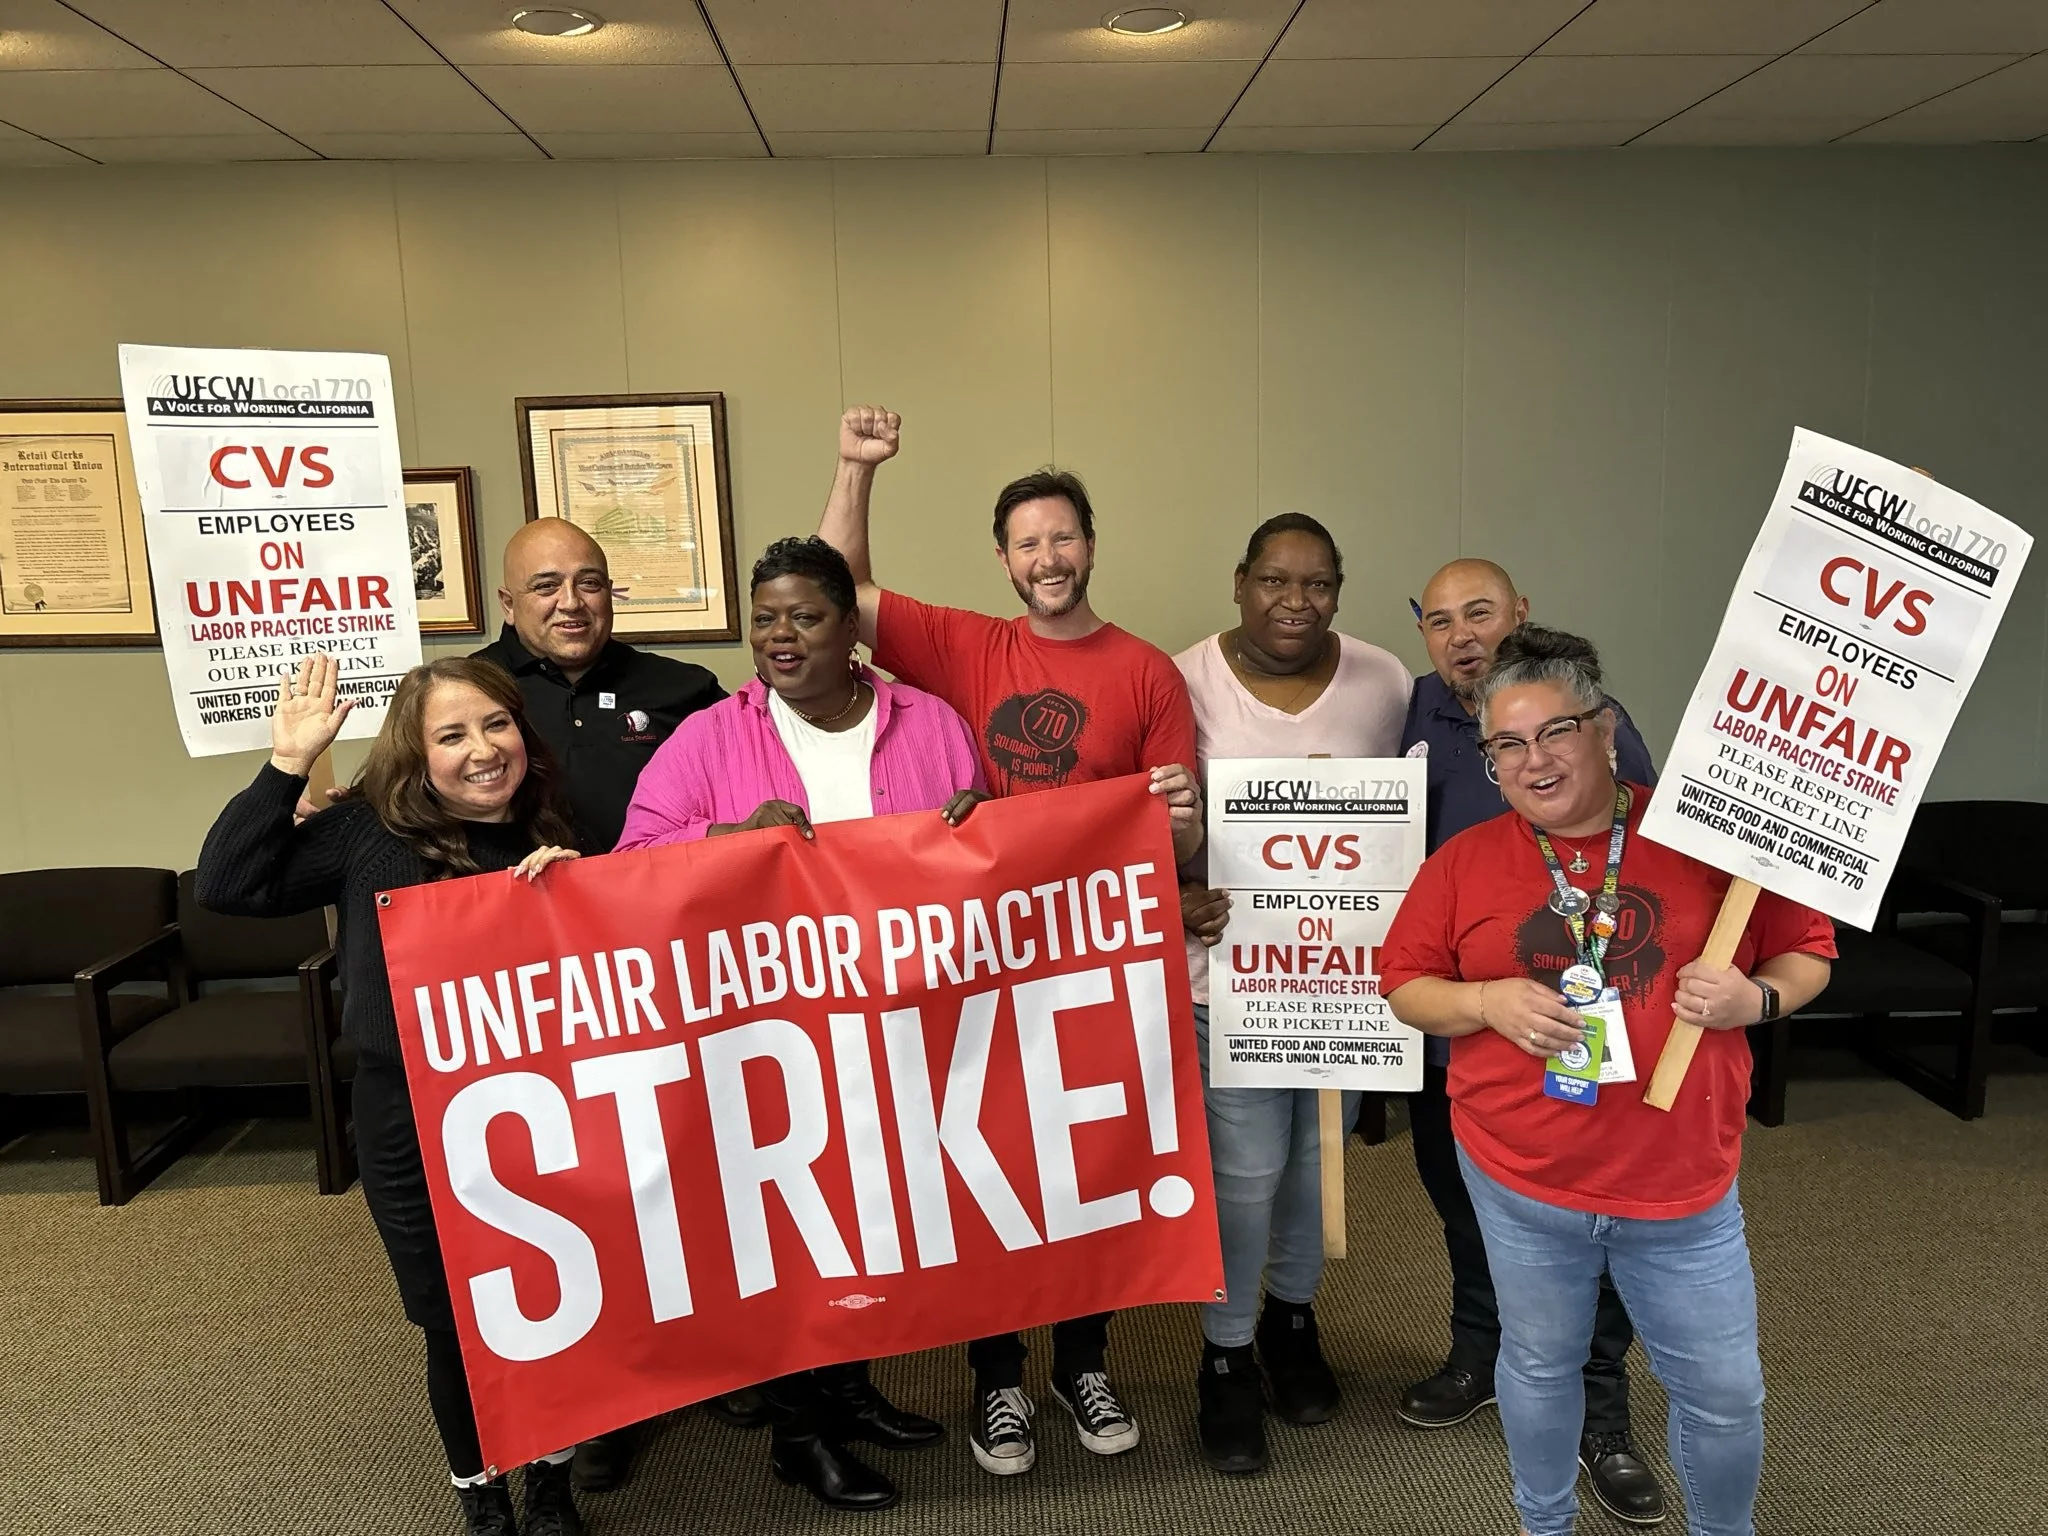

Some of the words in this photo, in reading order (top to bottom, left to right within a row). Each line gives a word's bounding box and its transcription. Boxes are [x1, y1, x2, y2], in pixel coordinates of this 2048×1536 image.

[171, 375, 254, 400] UFCW
[257, 377, 321, 400] Local
[325, 378, 371, 400] 770
[152, 401, 164, 412] A
[166, 401, 204, 413] VOICE
[208, 403, 231, 413] FOR
[234, 402, 296, 415] WORKING
[298, 402, 369, 415] CALIFORNIA
[3, 461, 68, 472] International
[73, 460, 103, 470] Union
[18, 450, 47, 460] Retail
[51, 450, 84, 460] Clerks
[209, 445, 334, 489] CVS
[198, 513, 355, 535] EMPLOYEES
[1832, 468, 1908, 522] UFCW
[1904, 502, 1963, 549] Local
[1961, 530, 2008, 568] 770
[1804, 486, 1815, 497] A
[1818, 491, 1850, 517] VOICE
[1852, 508, 1873, 527] FOR
[1875, 517, 1927, 552] WORKING
[1927, 543, 1992, 581] CALIFORNIA
[260, 541, 304, 571] ON
[186, 575, 392, 618] UNFAIR
[1820, 556, 1935, 637] CVS
[191, 622, 246, 642] LABOR
[251, 617, 333, 638] PRACTICE
[338, 614, 396, 633] STRIKE
[208, 643, 283, 662] PLEASE
[289, 637, 378, 655] RESPECT
[1778, 613, 1918, 690] EMPLOYEES
[208, 666, 251, 682] OUR
[255, 662, 302, 678] PICK
[337, 656, 385, 671] LINE
[197, 693, 241, 710] UNITED
[244, 689, 280, 704] FOOD
[336, 679, 398, 695] MMERCIAL
[1815, 665, 1859, 707] ON
[200, 707, 261, 725] WORKERS
[1031, 706, 1069, 739] 770
[1726, 668, 1913, 782] UNFAIR
[993, 733, 1042, 760] SOLIDARITY
[1712, 710, 1768, 750] LABOR
[1768, 734, 1845, 782] PRACTICE
[1843, 769, 1900, 807] STRIKE
[1011, 758, 1020, 771] IS
[1247, 780, 1311, 800] UFCW
[1315, 780, 1365, 800] Local
[1370, 780, 1408, 800] 770
[1718, 743, 1787, 784] PLEASE
[1790, 775, 1873, 821] RESPECT
[1229, 801, 1238, 811] A
[1240, 801, 1270, 811] VOICE
[1272, 802, 1291, 811] FOR
[1293, 801, 1342, 812] WORKING
[1344, 801, 1404, 812] CALIFORNIA
[1707, 763, 1747, 791] OUR
[1751, 781, 1820, 823] PICKET
[1819, 812, 1868, 844] LINE
[1681, 783, 1727, 813] UNITED
[1728, 803, 1762, 828] FOOD
[1762, 819, 1789, 841] AND
[1790, 831, 1869, 875] COMMERCIAL
[1262, 834, 1361, 871] CVS
[1676, 799, 1736, 836] WORKERS
[1737, 826, 1776, 854] UNION
[1777, 843, 1815, 871] LOCAL
[1817, 860, 1838, 881] NO.
[1843, 870, 1865, 891] 770
[1253, 894, 1380, 911] EMPLOYEES
[1298, 916, 1333, 941] ON
[413, 946, 666, 1074] UNFAIR
[671, 912, 869, 1025] LABOR
[879, 861, 1165, 996] PRACTICE
[1232, 978, 1276, 993] LABOR
[1281, 979, 1348, 995] PRACTICE
[1351, 980, 1381, 995] STRI
[1246, 1001, 1307, 1014] PLEASE
[1312, 1002, 1387, 1015] RESPECT
[1242, 1017, 1279, 1030] OUR
[1283, 1018, 1344, 1031] PICKET
[1348, 1019, 1390, 1032] LINE
[1229, 1038, 1268, 1050] UNITED
[1271, 1039, 1300, 1051] FOOD
[1303, 1040, 1326, 1051] AND
[1329, 1040, 1404, 1053] COMMERCIAL
[1230, 1052, 1283, 1064] WORKERS
[1286, 1052, 1320, 1064] UNION
[1323, 1053, 1358, 1065] LOCAL
[1361, 1053, 1380, 1065] NO.
[1383, 1055, 1403, 1066] 770
[440, 959, 1196, 1363] STRIKE!
